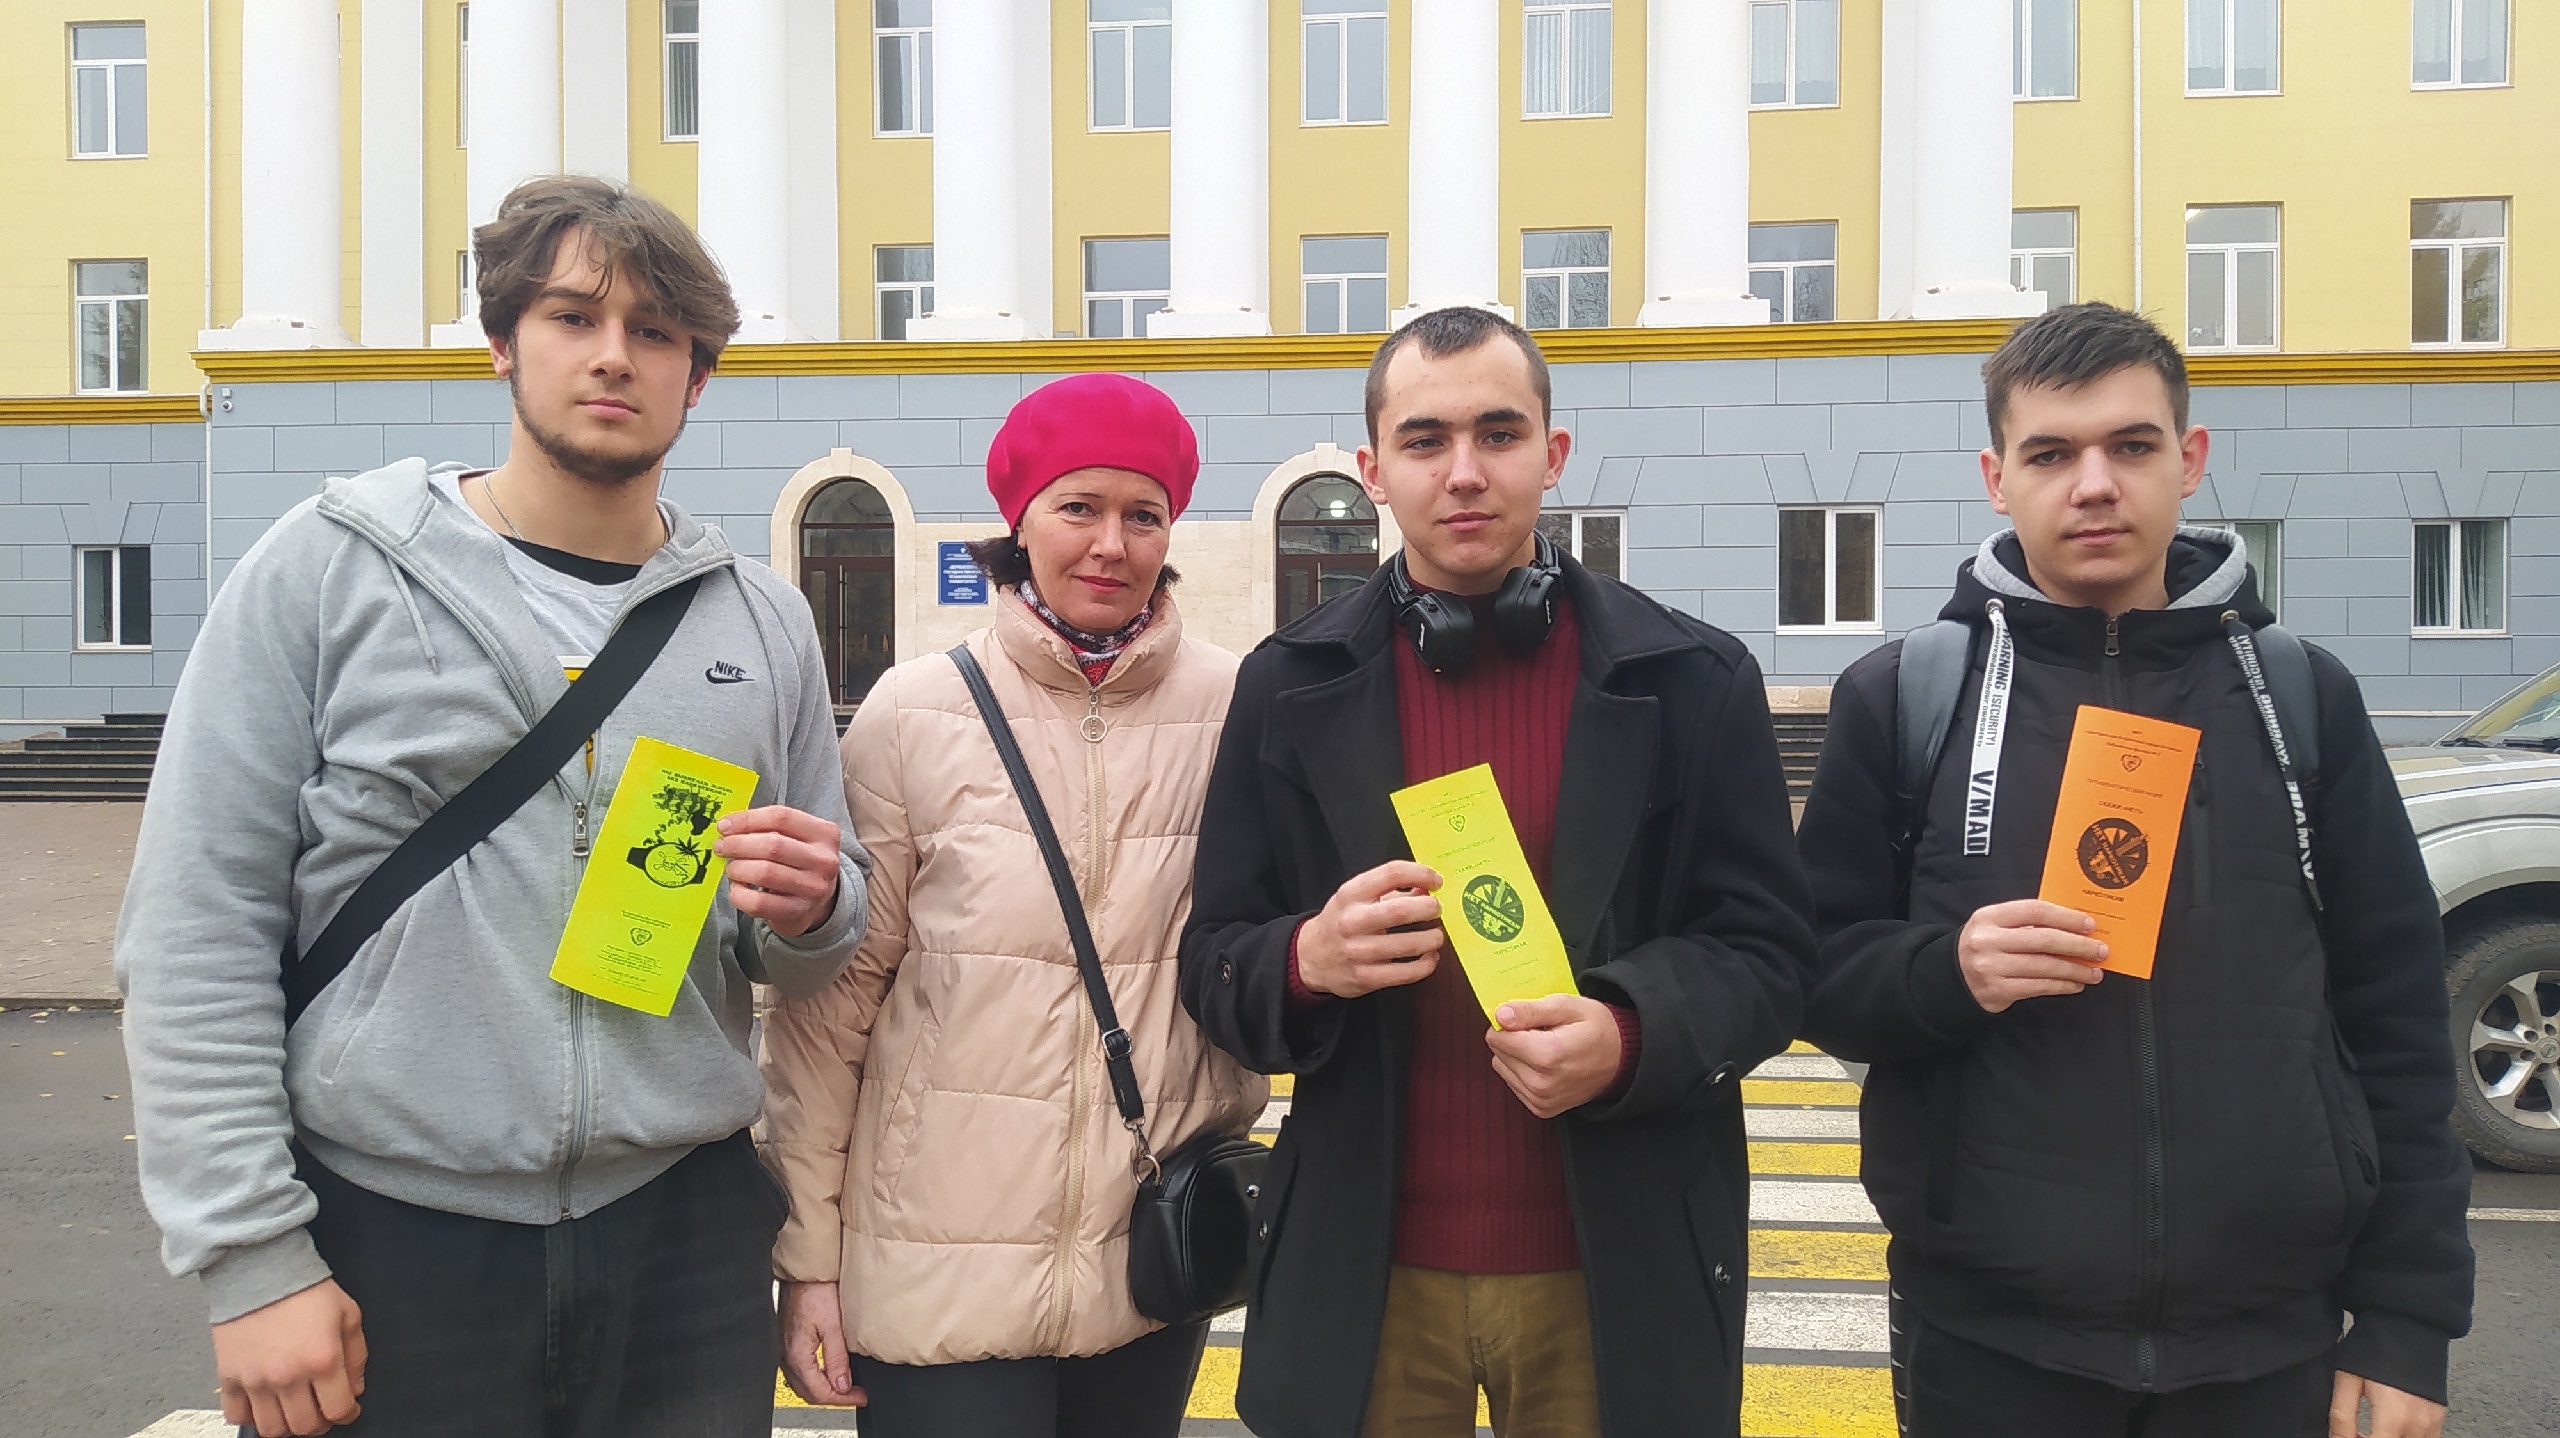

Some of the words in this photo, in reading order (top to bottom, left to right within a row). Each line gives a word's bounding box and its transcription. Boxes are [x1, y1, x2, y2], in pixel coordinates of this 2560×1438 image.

[1994, 627, 2012, 691] WARNING
[714, 660, 747, 680] NIKE
[1463, 890, 1482, 905] НЕТ
